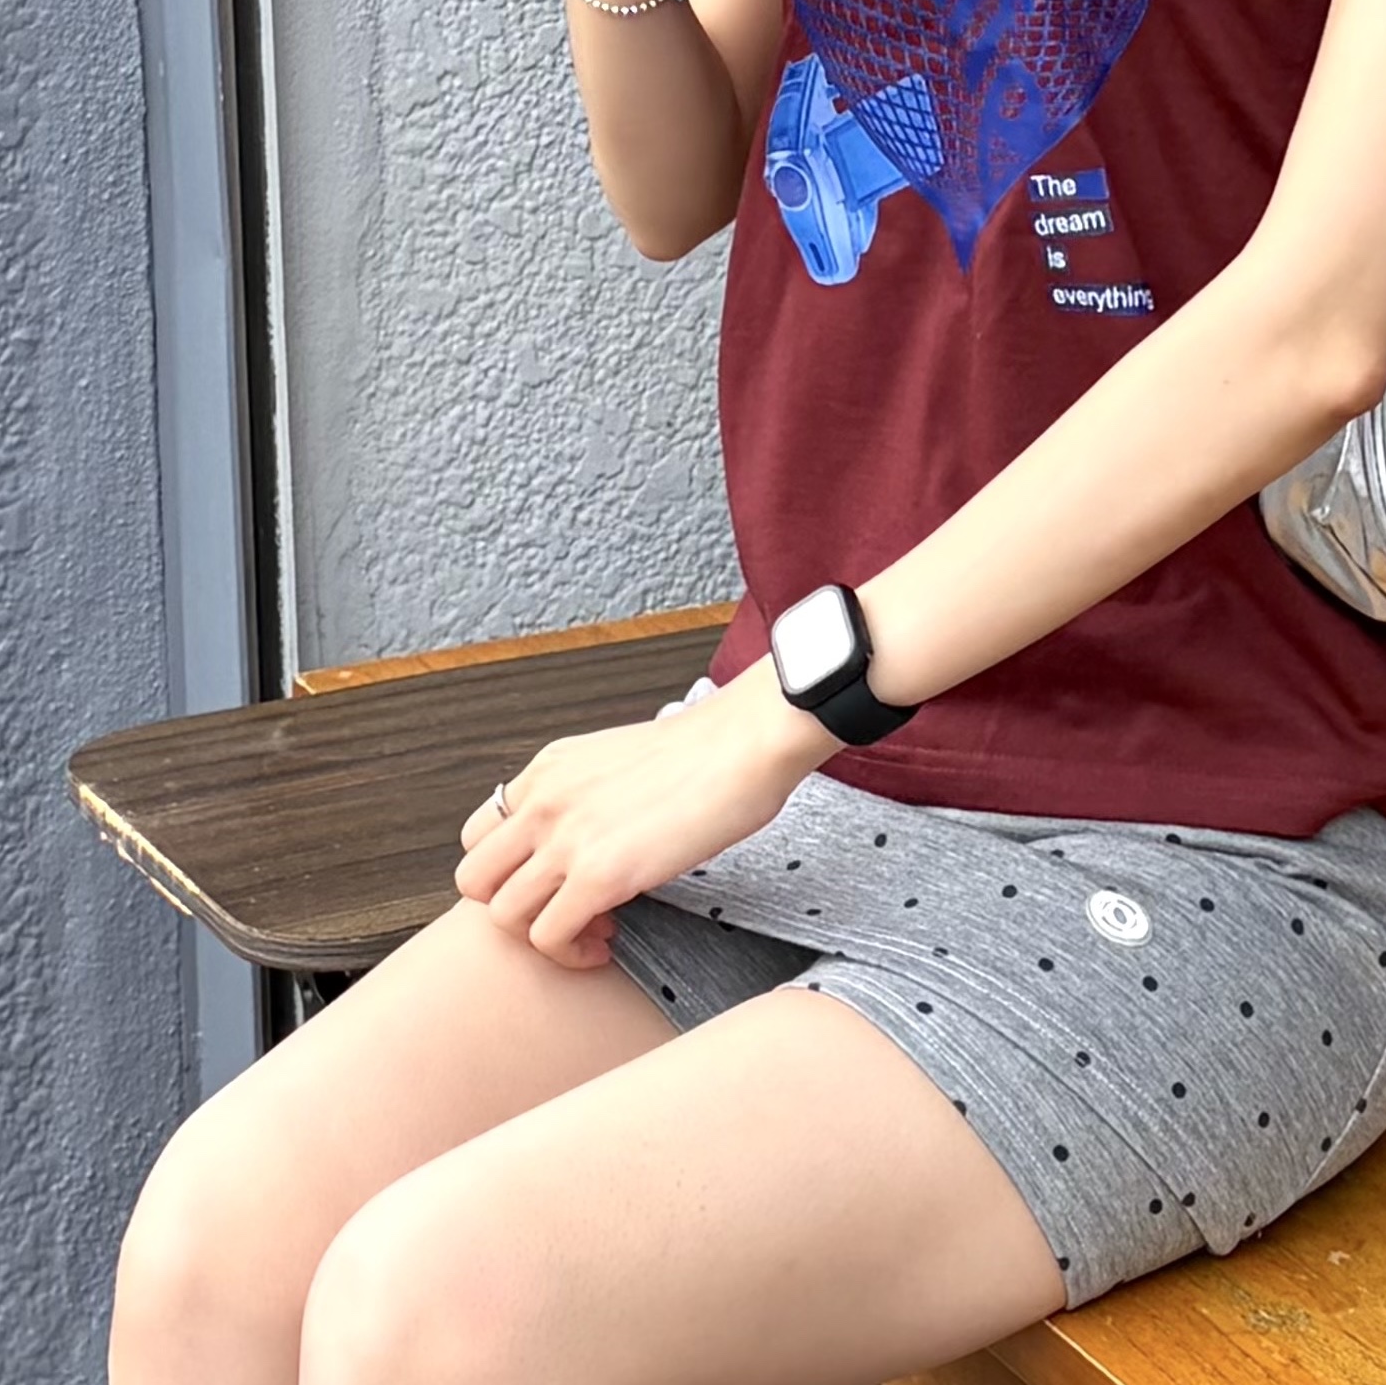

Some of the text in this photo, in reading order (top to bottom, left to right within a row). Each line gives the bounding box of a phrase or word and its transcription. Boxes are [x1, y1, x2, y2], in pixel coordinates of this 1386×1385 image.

[1030, 174, 1077, 198] The
[1034, 210, 1106, 236] dream
[1046, 245, 1067, 269] is
